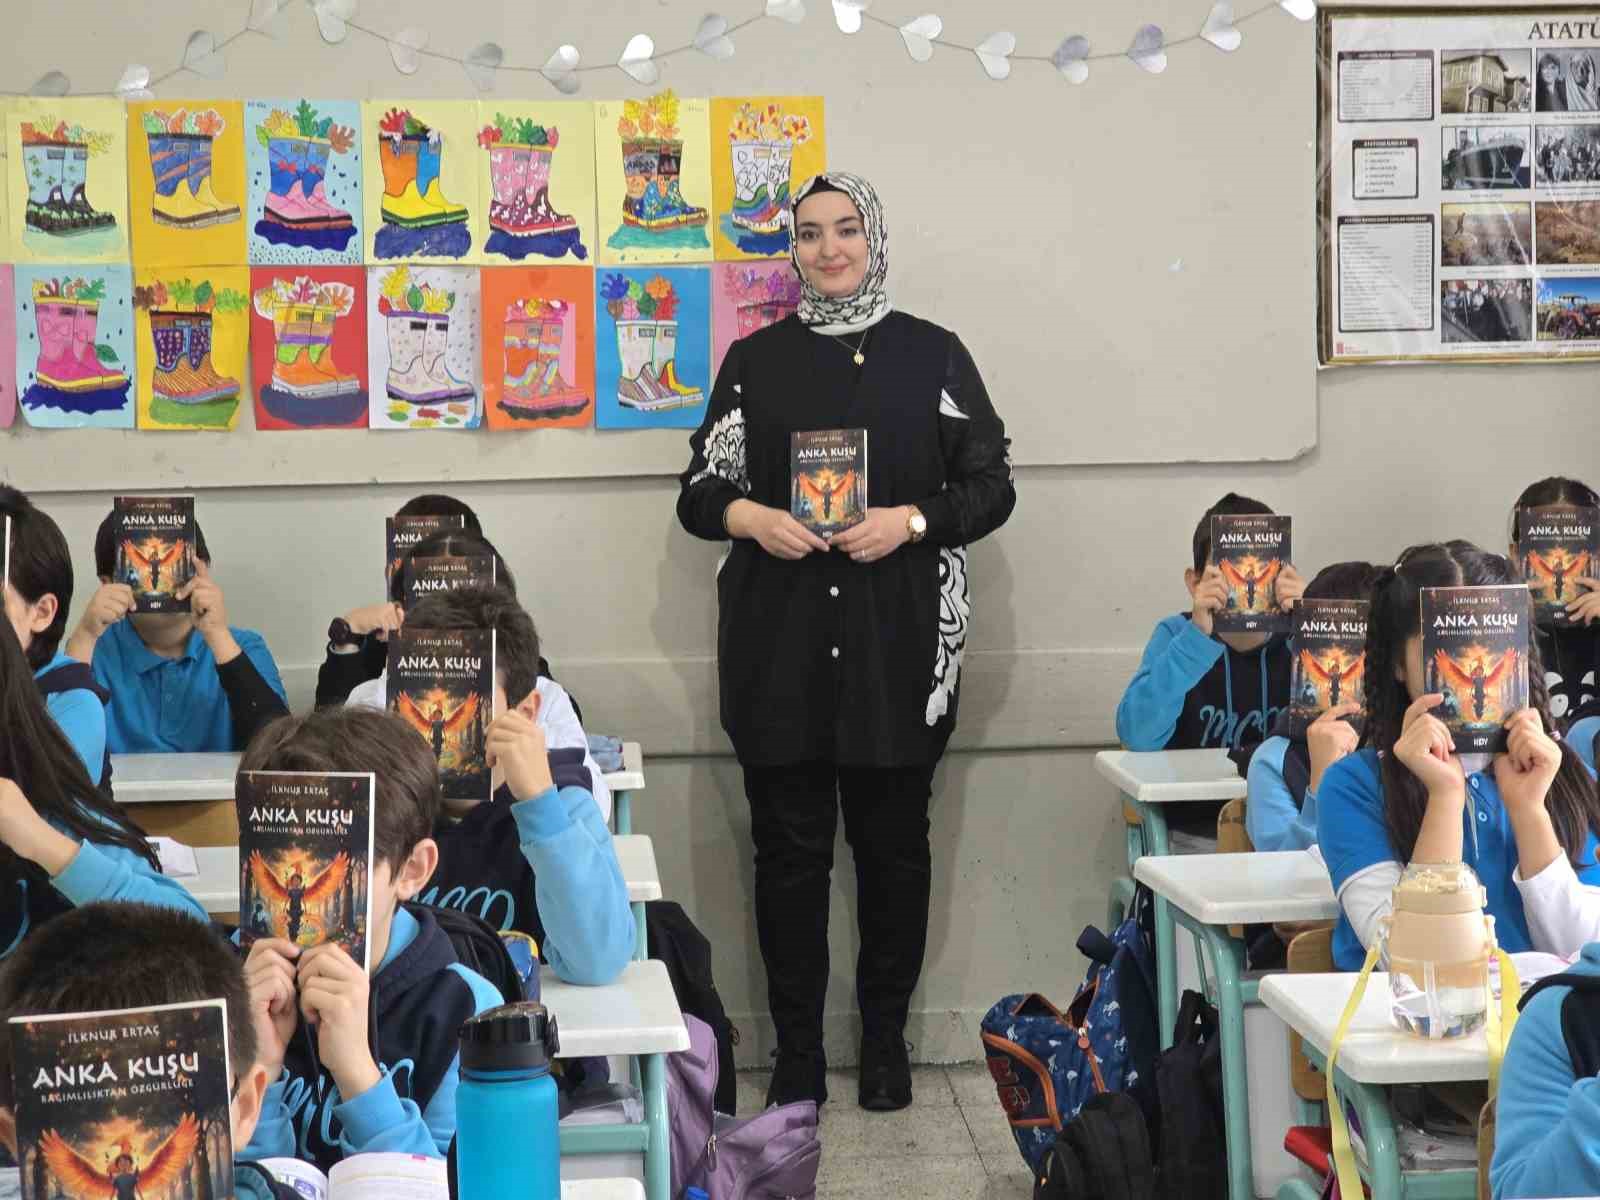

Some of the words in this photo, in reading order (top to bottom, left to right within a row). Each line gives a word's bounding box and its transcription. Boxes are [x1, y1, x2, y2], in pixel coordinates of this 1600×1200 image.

[797, 447, 827, 459] ANKA
[830, 446, 857, 458] KUŞU
[122, 514, 155, 525] ANKA
[158, 514, 186, 526] KUŞU
[1527, 525, 1560, 536] ANKA
[1563, 525, 1591, 536] KUŞU
[393, 533, 423, 543] ANKA
[1220, 533, 1251, 543] ANKA
[1255, 532, 1282, 544] KUŞU
[412, 579, 448, 591] ANKA
[1300, 620, 1337, 632] ANKA
[1433, 615, 1478, 628] ANKA
[1483, 613, 1518, 628] KUŞU
[397, 655, 440, 669] ANKA
[444, 656, 482, 673] KUŞU
[249, 806, 299, 823] ANKA
[305, 807, 354, 828] KUŞU
[33, 1061, 118, 1089] ANKA
[128, 1051, 199, 1079] KUŞU
